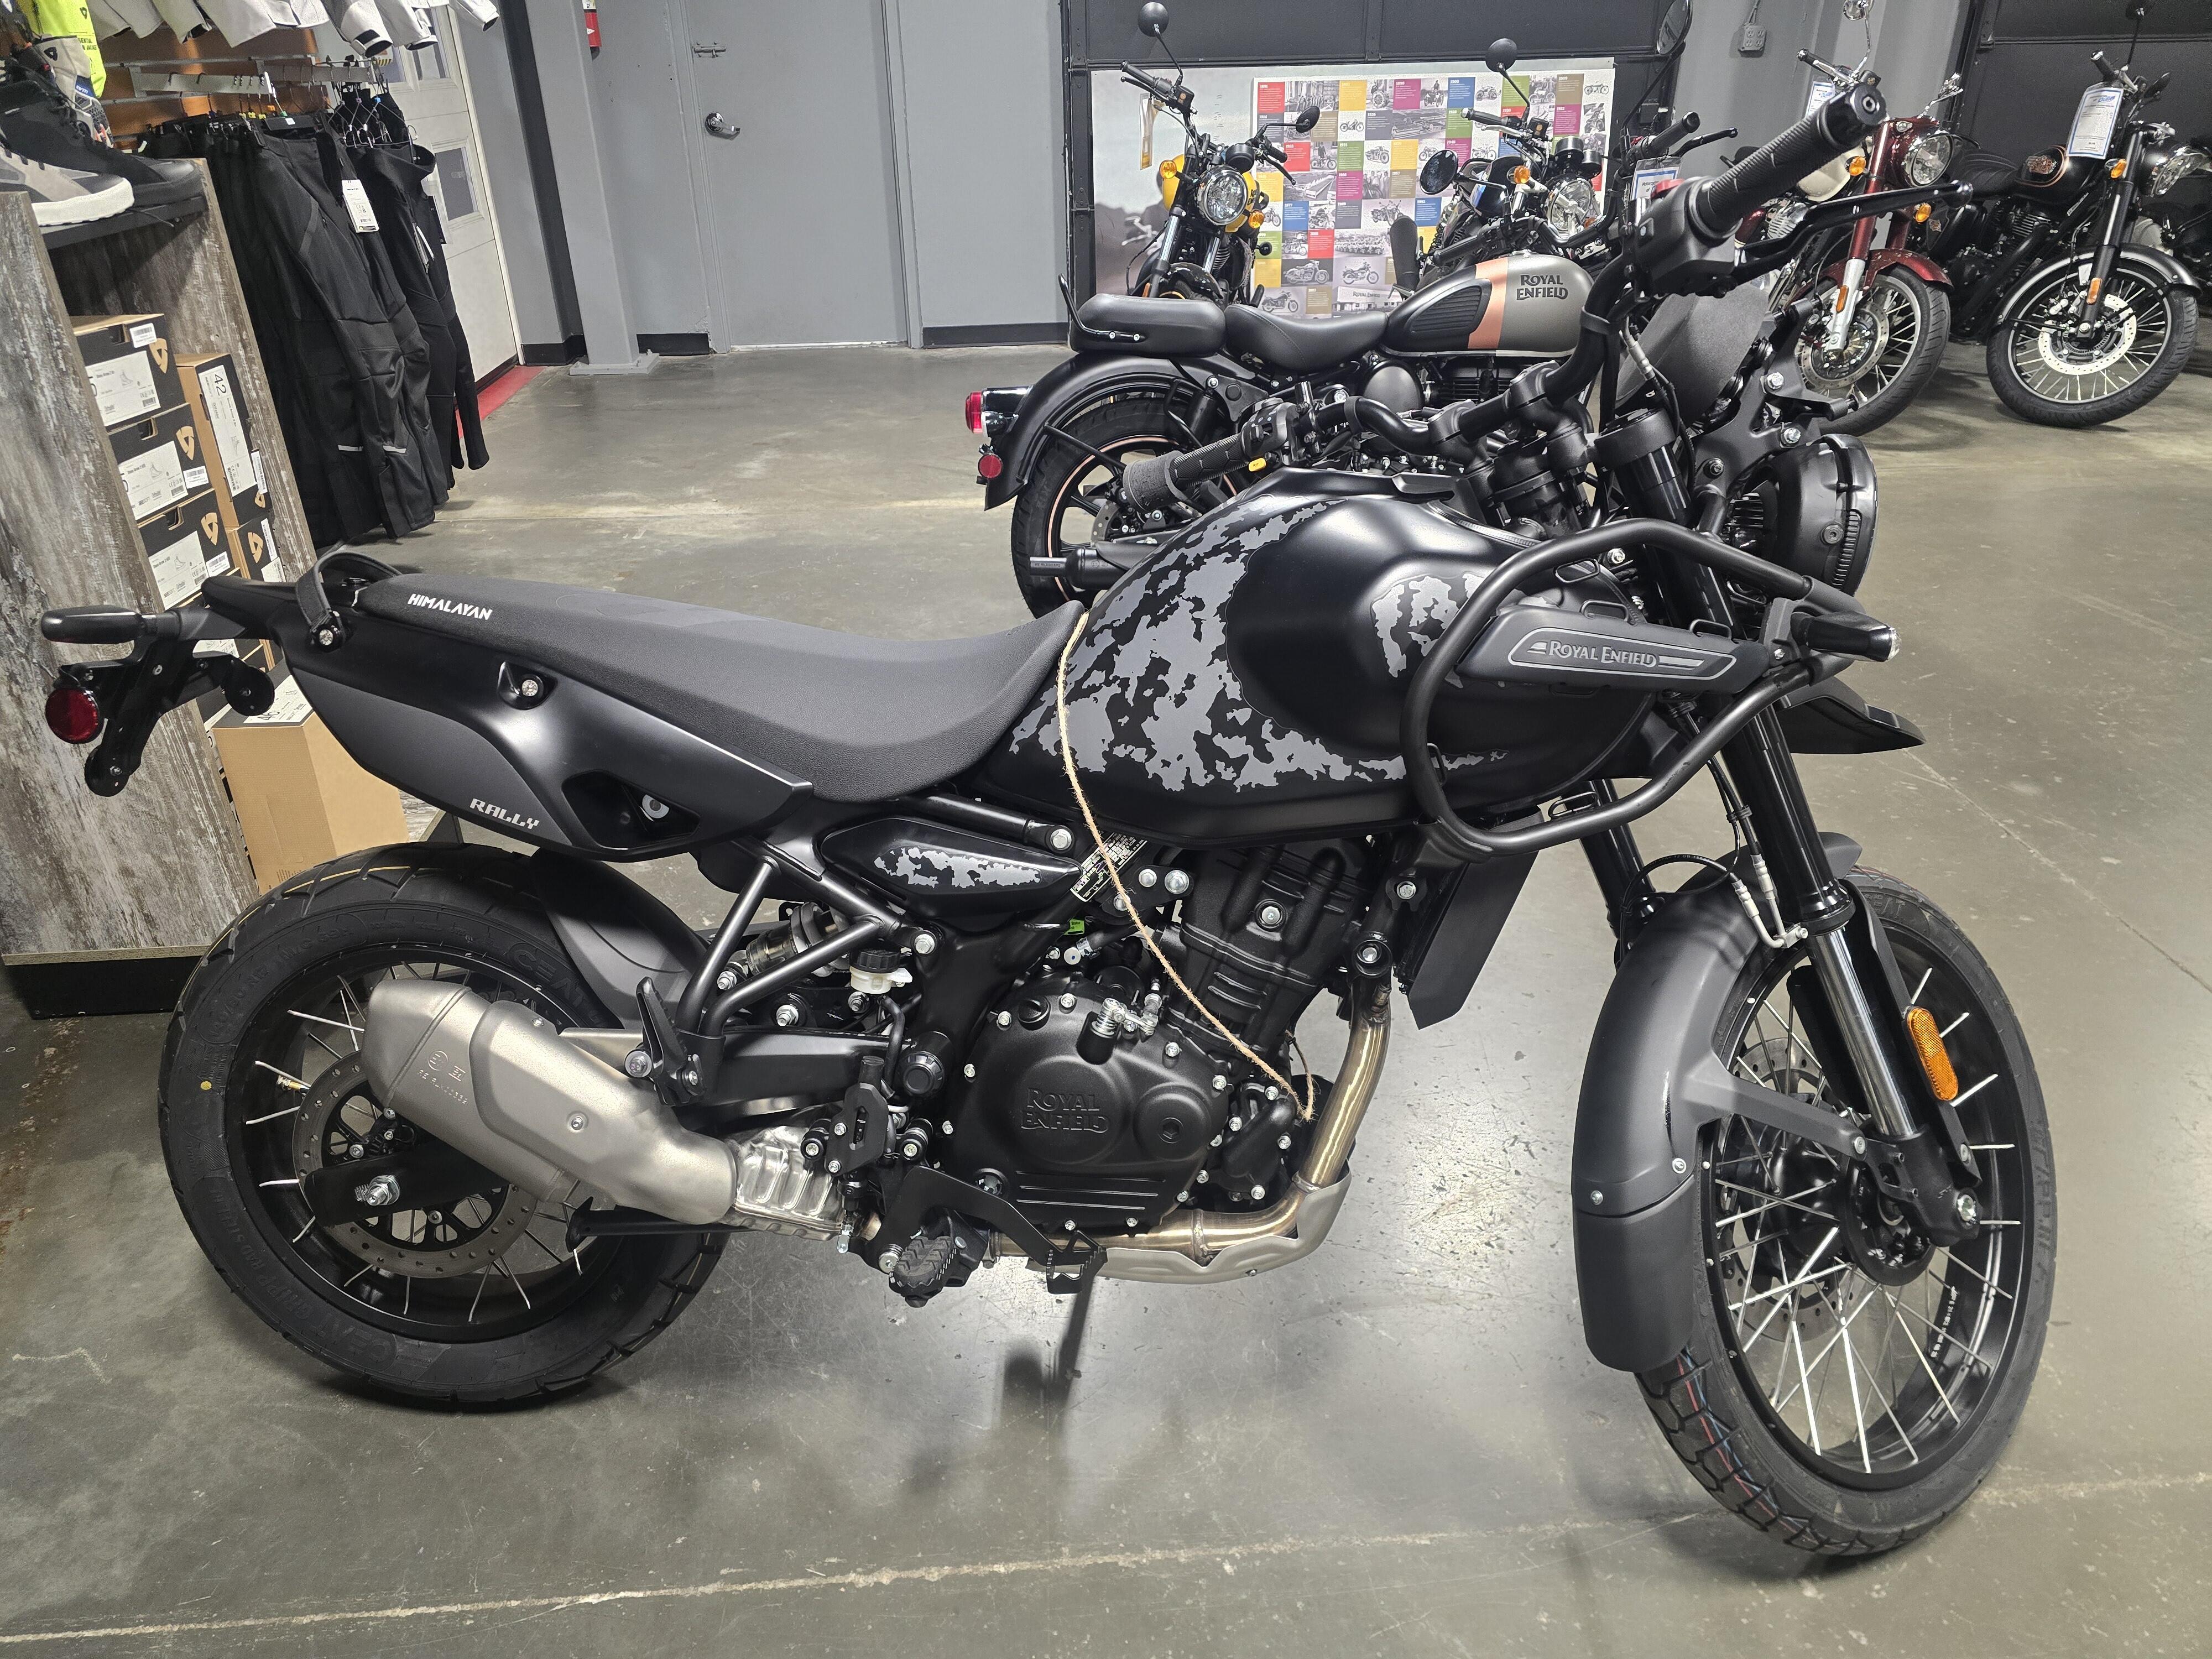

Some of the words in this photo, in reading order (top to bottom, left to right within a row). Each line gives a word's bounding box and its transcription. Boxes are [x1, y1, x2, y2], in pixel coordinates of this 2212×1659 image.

[1520, 274, 1563, 286] ROYAL
[1516, 287, 1568, 301] ENFIELD
[215, 374, 227, 397] 42
[407, 593, 493, 620] HIMALAYAN
[1549, 641, 1598, 660] ROYAL
[1601, 646, 1658, 667] ENFIELD
[469, 798, 540, 830] RALLY
[1027, 1087, 1100, 1112] ROYAL
[1021, 1112, 1111, 1134] ENFIELD
